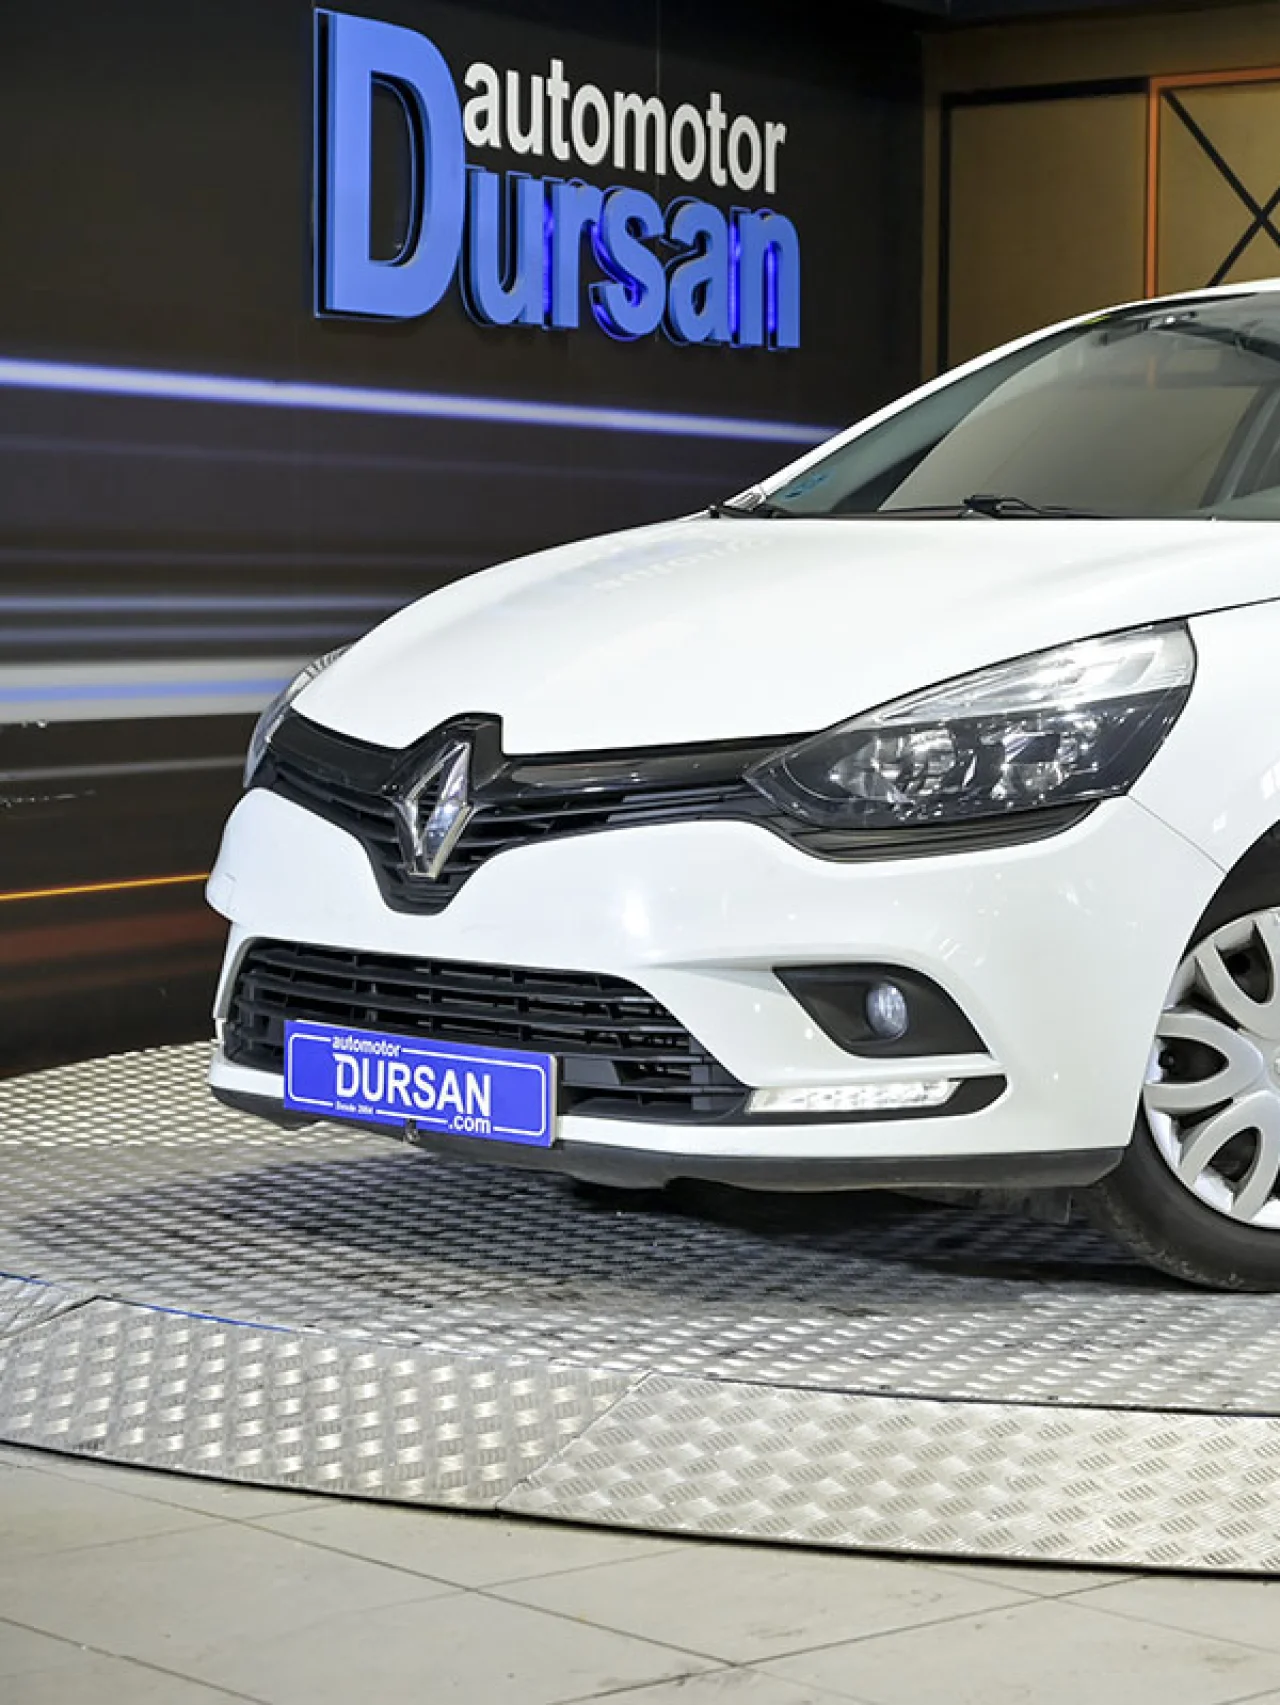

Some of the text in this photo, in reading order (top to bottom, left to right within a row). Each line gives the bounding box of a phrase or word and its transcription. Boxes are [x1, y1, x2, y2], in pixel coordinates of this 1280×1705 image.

[463, 59, 787, 194] automotor
[314, 8, 801, 350] Dursan
[332, 1035, 401, 1057] automotor
[332, 1053, 491, 1117] DURSAN
[448, 1115, 491, 1134] .com
